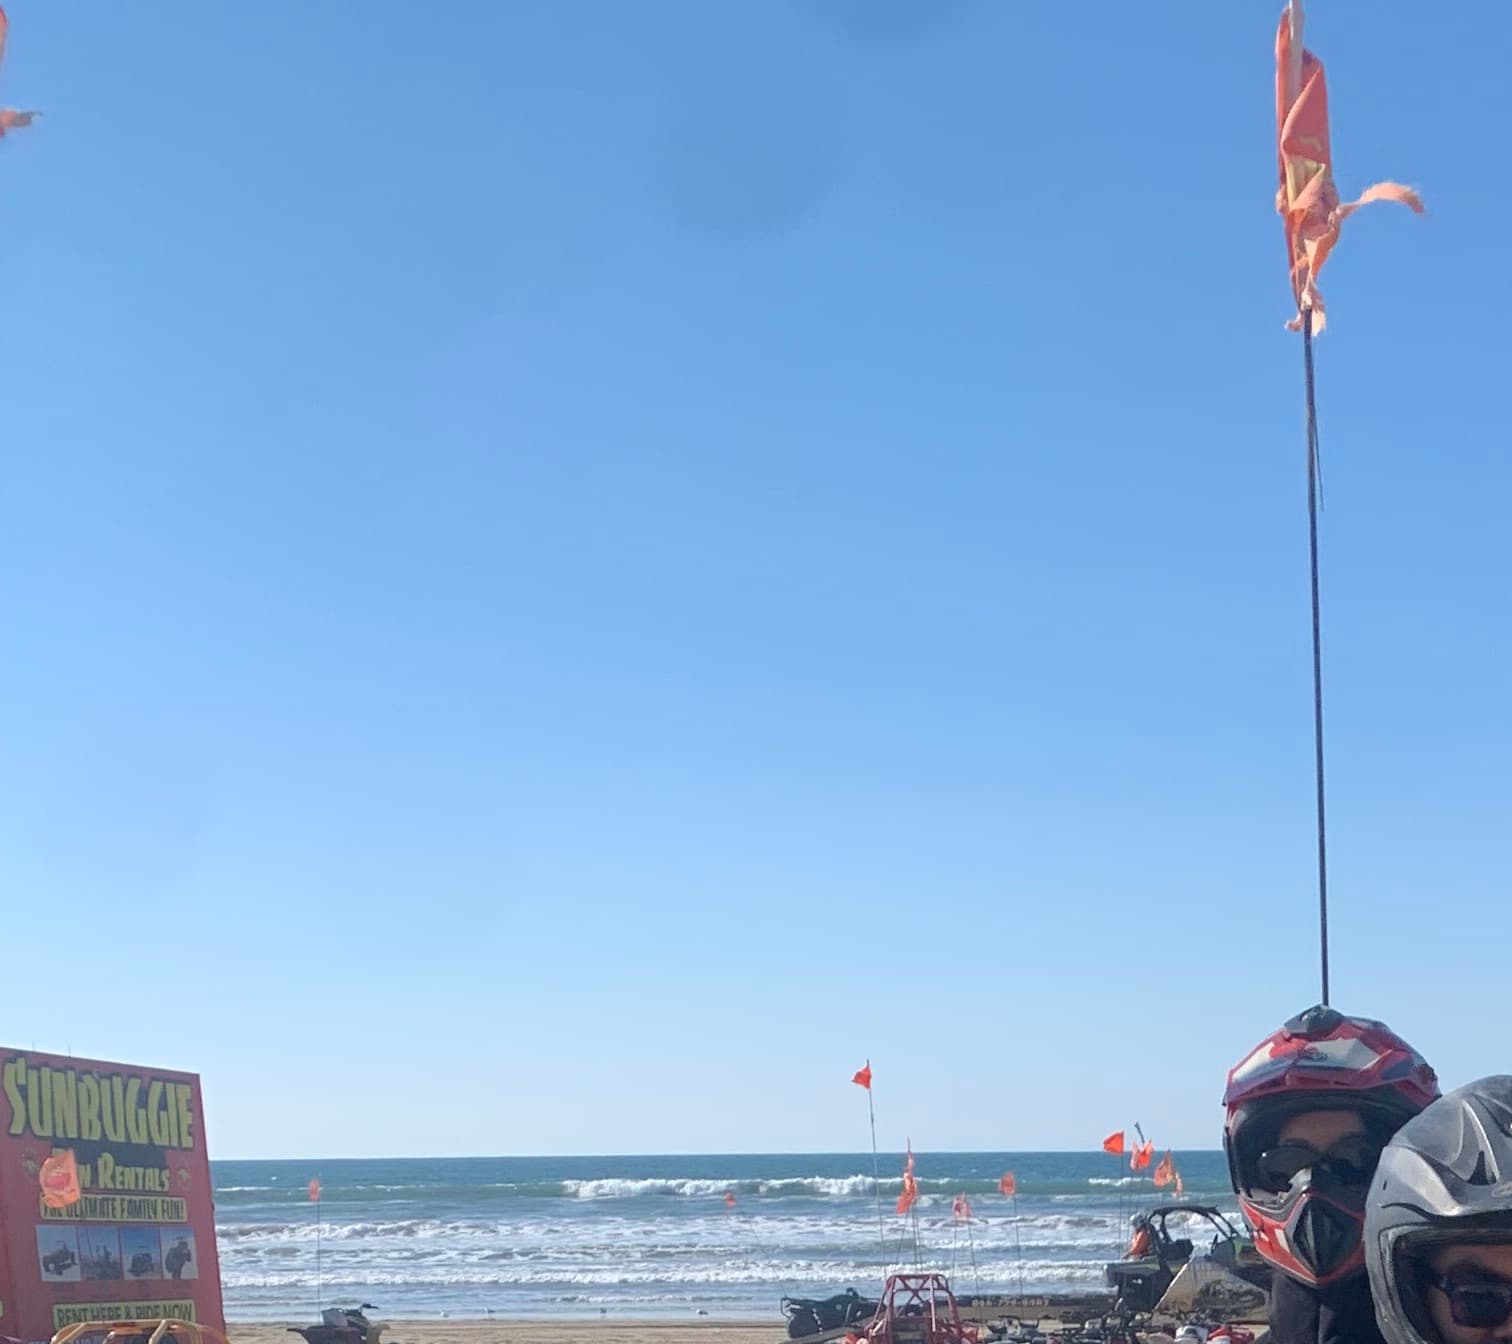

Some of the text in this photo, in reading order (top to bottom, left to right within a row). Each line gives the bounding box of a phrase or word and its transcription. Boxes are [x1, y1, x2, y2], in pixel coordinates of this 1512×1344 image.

[4, 1057, 193, 1147] SUNBUGGIE
[98, 1152, 170, 1192] RENTALS
[120, 1197, 157, 1220] FAMILY
